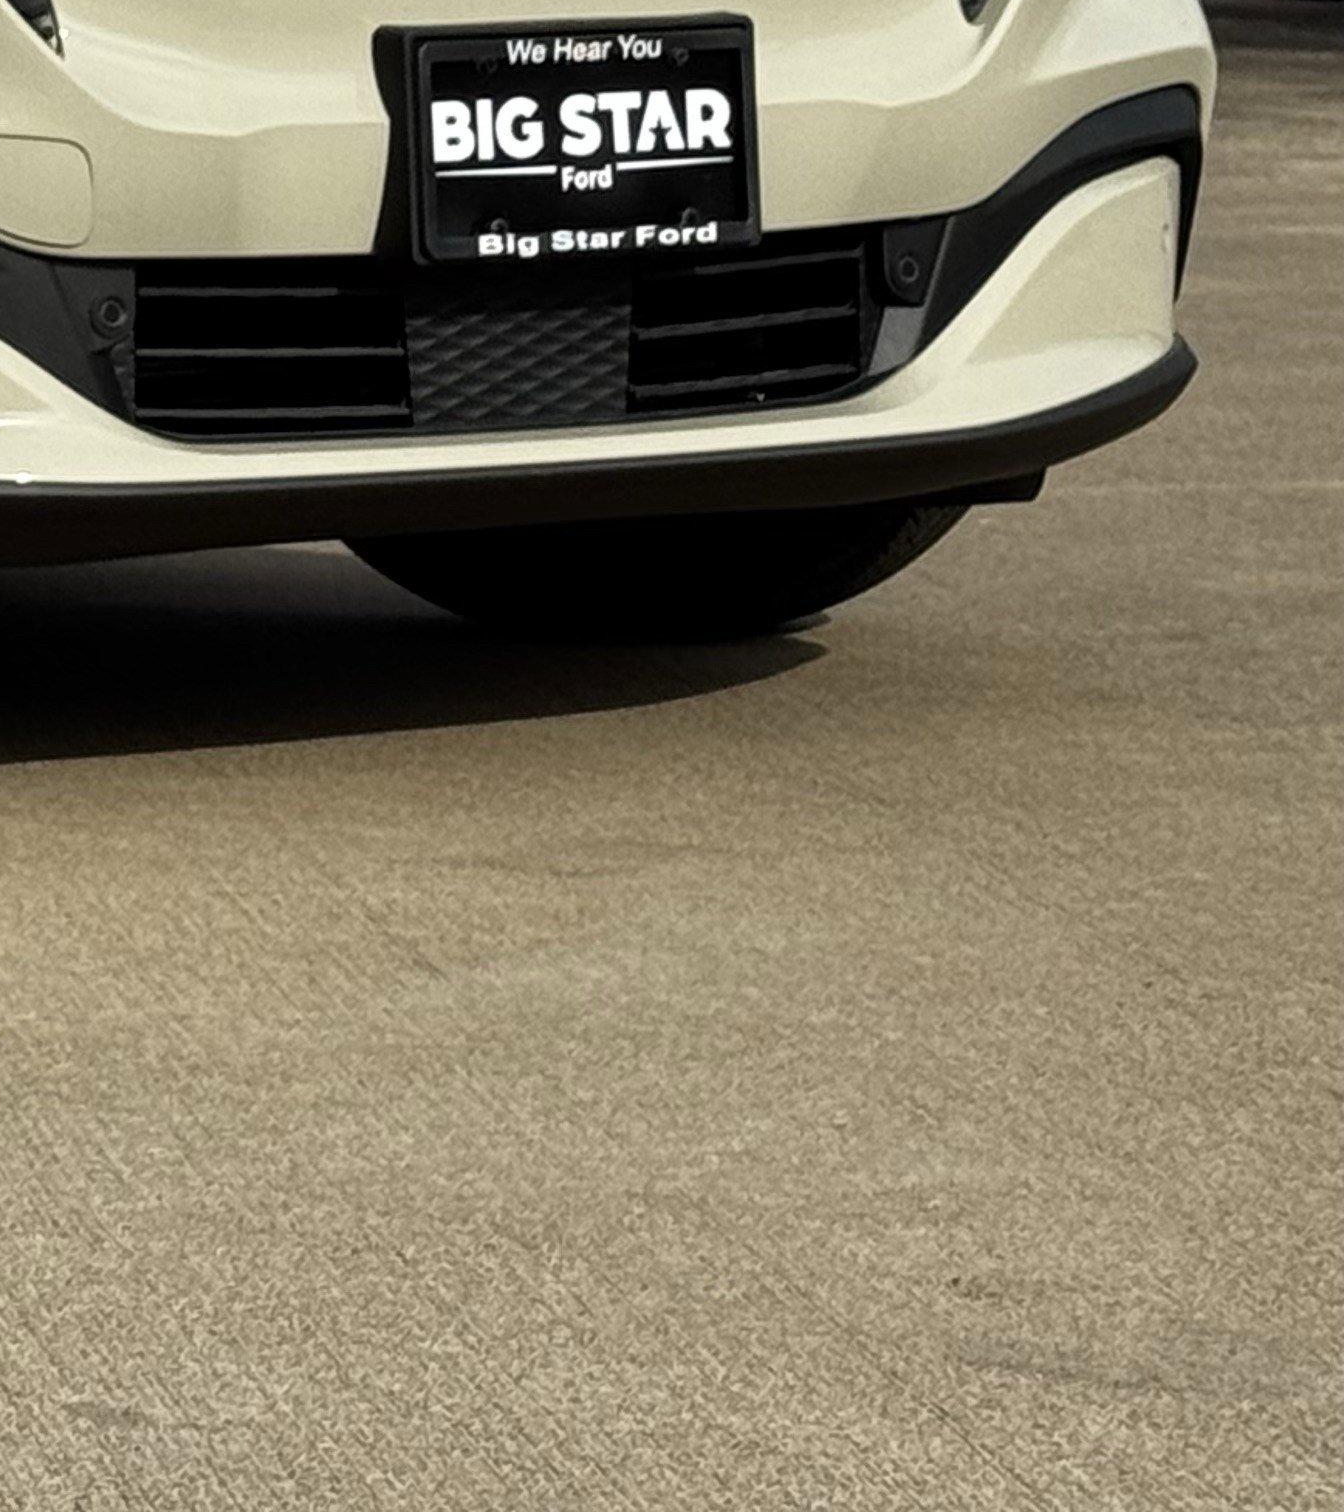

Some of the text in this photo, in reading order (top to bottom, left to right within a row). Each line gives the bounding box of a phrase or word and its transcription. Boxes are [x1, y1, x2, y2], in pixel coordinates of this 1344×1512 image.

[506, 35, 662, 64] We Hear You
[431, 88, 732, 164] BIG STAR
[561, 165, 613, 192] Ford
[478, 221, 718, 258] Big Star Ford
